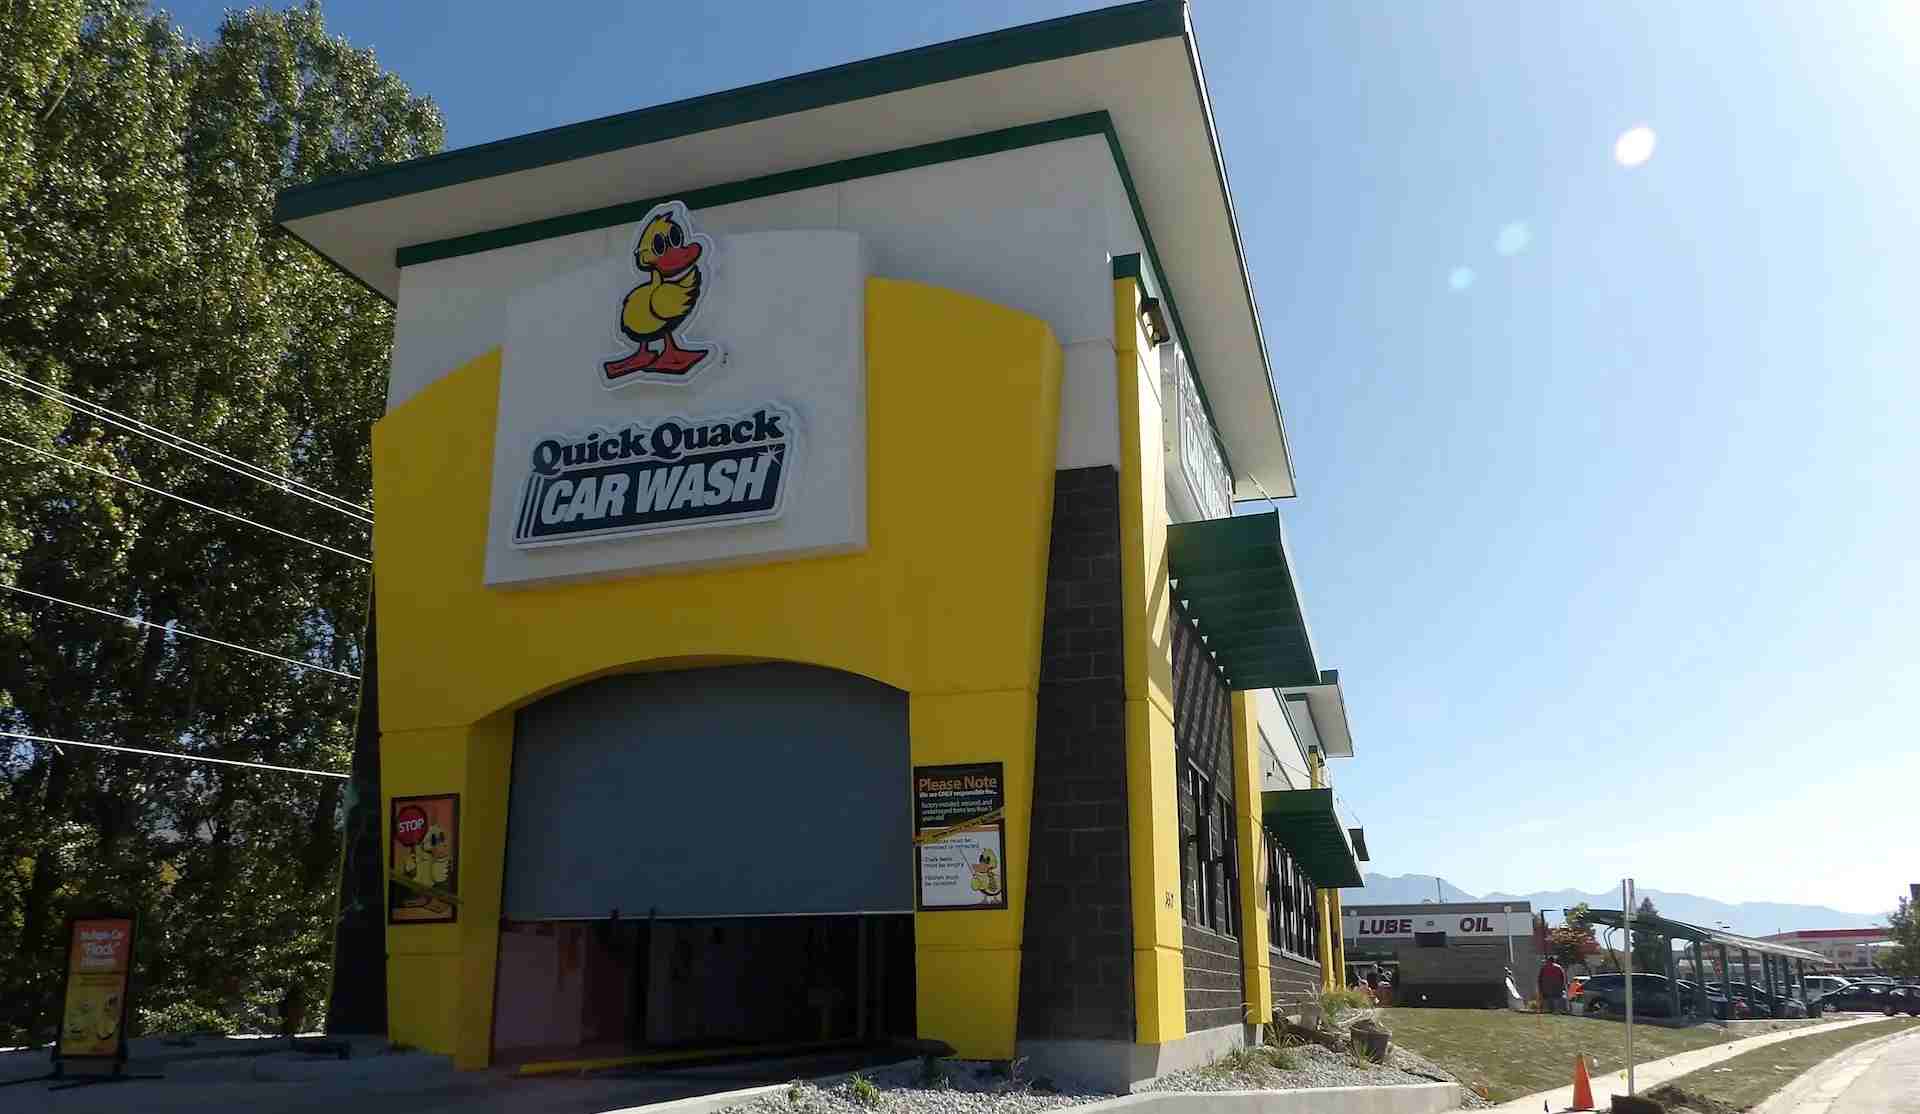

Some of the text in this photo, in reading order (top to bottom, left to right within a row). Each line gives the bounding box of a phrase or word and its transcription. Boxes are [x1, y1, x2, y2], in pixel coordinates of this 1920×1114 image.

[533, 410, 785, 475] Quick Quack
[541, 455, 771, 525] CAR WASH
[919, 776, 998, 792] Please Note
[400, 818, 425, 833] STOP
[1359, 917, 1494, 935] LUBE OIL
